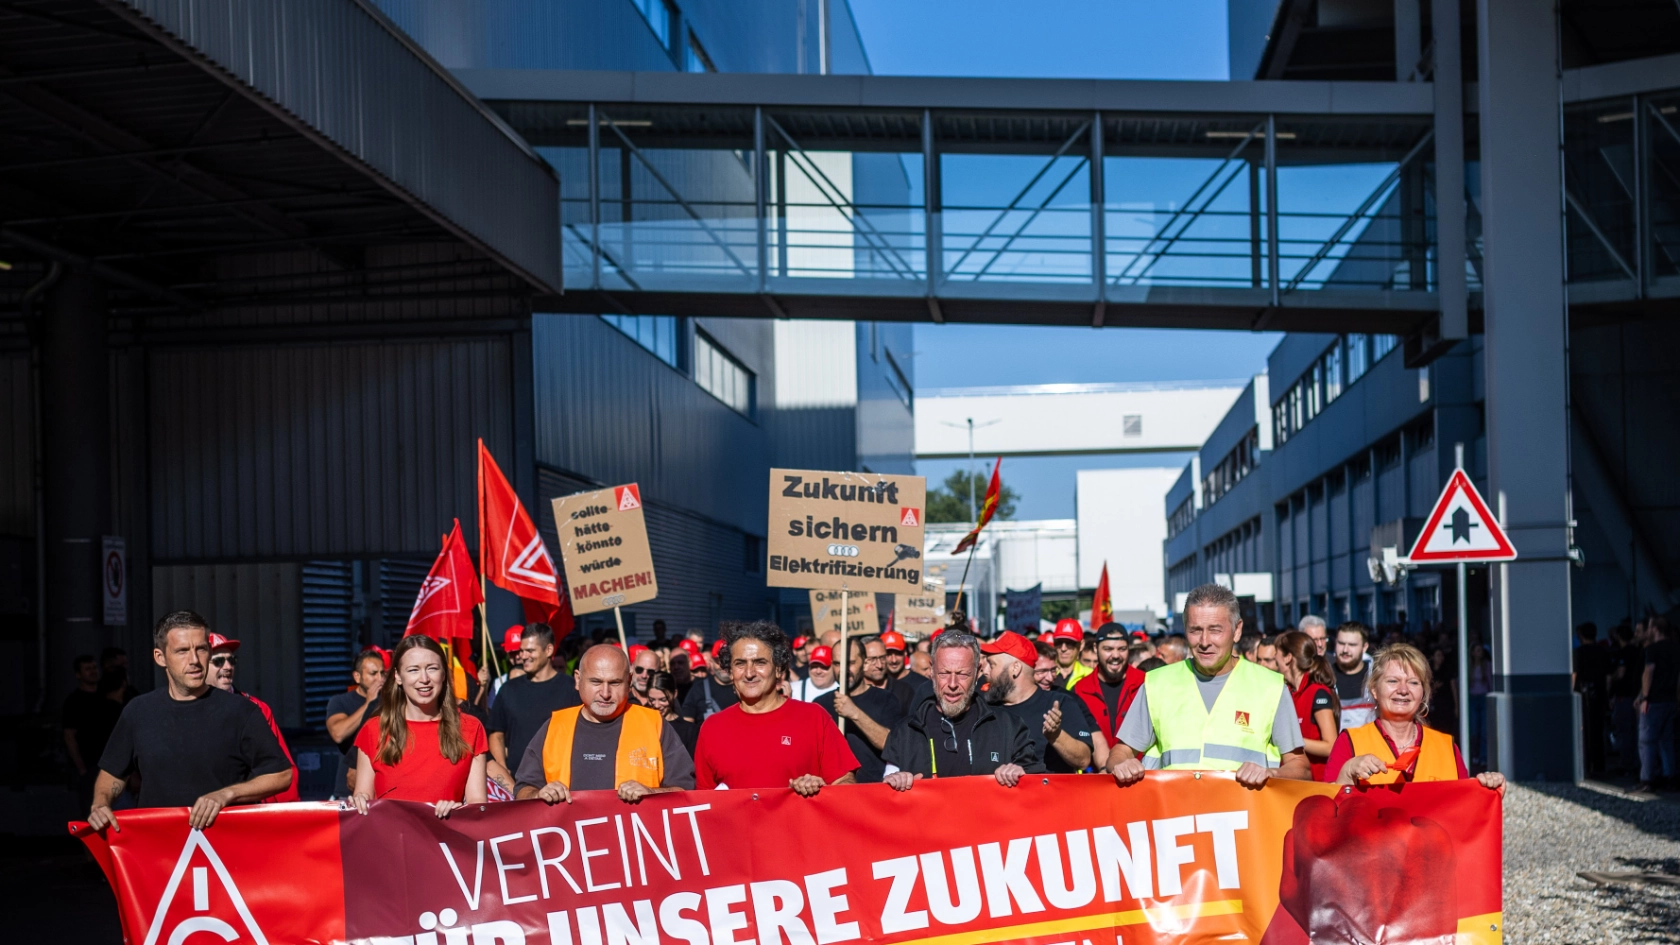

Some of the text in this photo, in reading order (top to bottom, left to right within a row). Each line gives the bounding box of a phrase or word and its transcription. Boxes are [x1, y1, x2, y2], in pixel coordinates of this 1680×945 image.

[782, 475, 899, 505] Zukunft
[571, 505, 608, 520] sollte
[574, 522, 611, 537] hätte
[788, 515, 898, 543] sichern
[576, 536, 623, 554] könnte
[580, 556, 622, 574] würde
[769, 555, 920, 585] Elektrifizierung
[573, 571, 653, 600] MACHEN!
[908, 598, 935, 608] NSU
[439, 805, 711, 911] VEREINT
[872, 810, 1249, 934] ZUKUNFT
